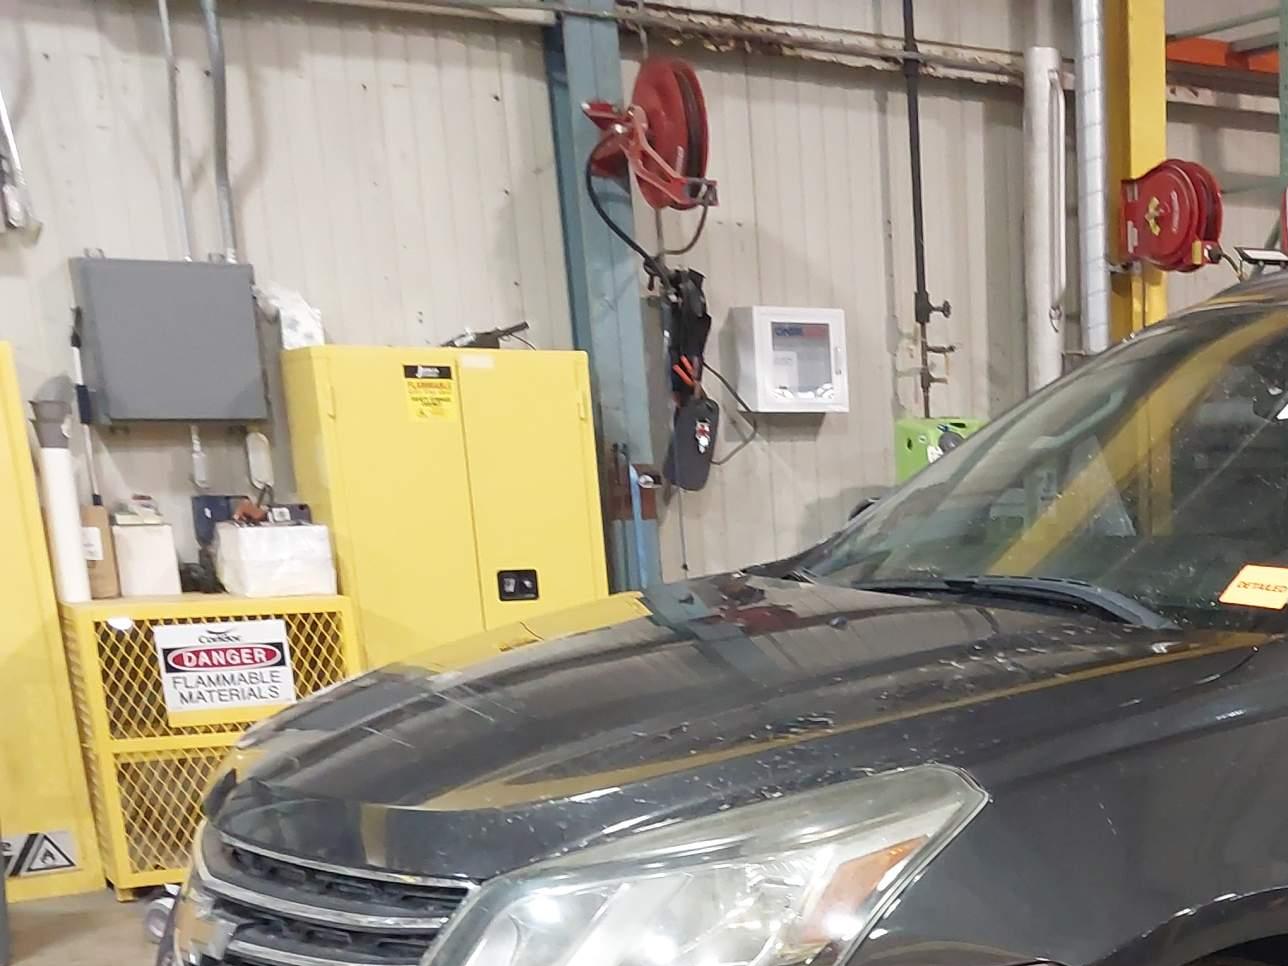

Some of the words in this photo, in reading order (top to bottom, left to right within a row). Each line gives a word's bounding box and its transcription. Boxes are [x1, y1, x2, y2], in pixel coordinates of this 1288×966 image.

[182, 649, 267, 668] DANGER
[172, 671, 281, 689] FLAMMABLE
[179, 685, 280, 704] MATERIALS
